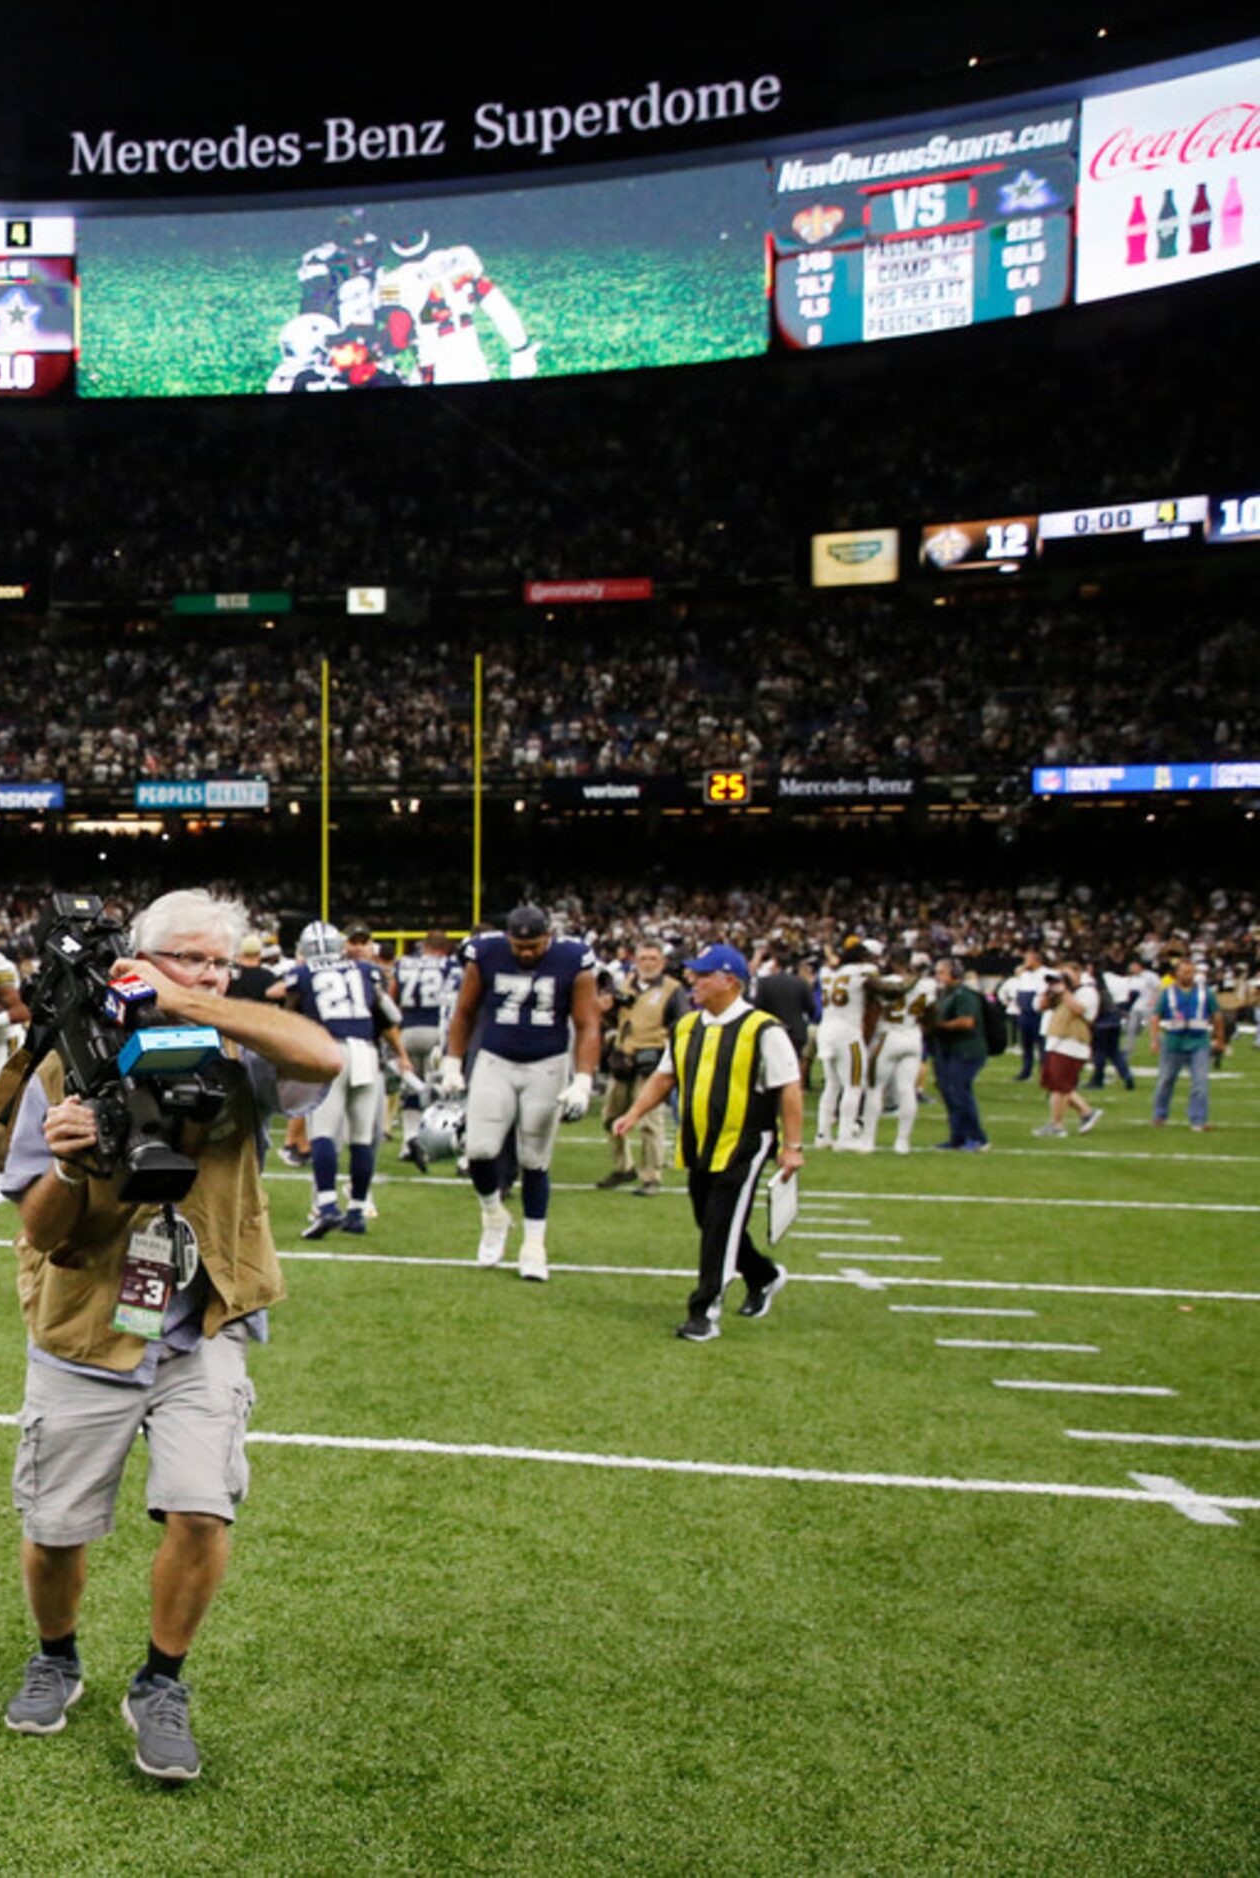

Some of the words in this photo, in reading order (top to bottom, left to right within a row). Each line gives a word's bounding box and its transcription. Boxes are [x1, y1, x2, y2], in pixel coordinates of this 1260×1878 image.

[70, 116, 446, 176] Mercedes-Benz
[473, 72, 782, 152] Superdome
[891, 182, 946, 230] VS
[877, 262, 931, 284] COMP
[1074, 510, 1133, 534] 0:00
[986, 523, 1029, 558] 12
[138, 786, 203, 804] PEOPLES
[710, 774, 745, 800] 25
[778, 776, 914, 796] Mercedes-Benz
[311, 969, 373, 1021] 21
[398, 967, 443, 1008] 72
[494, 972, 557, 1026] 71
[142, 1279, 166, 1306] 3
